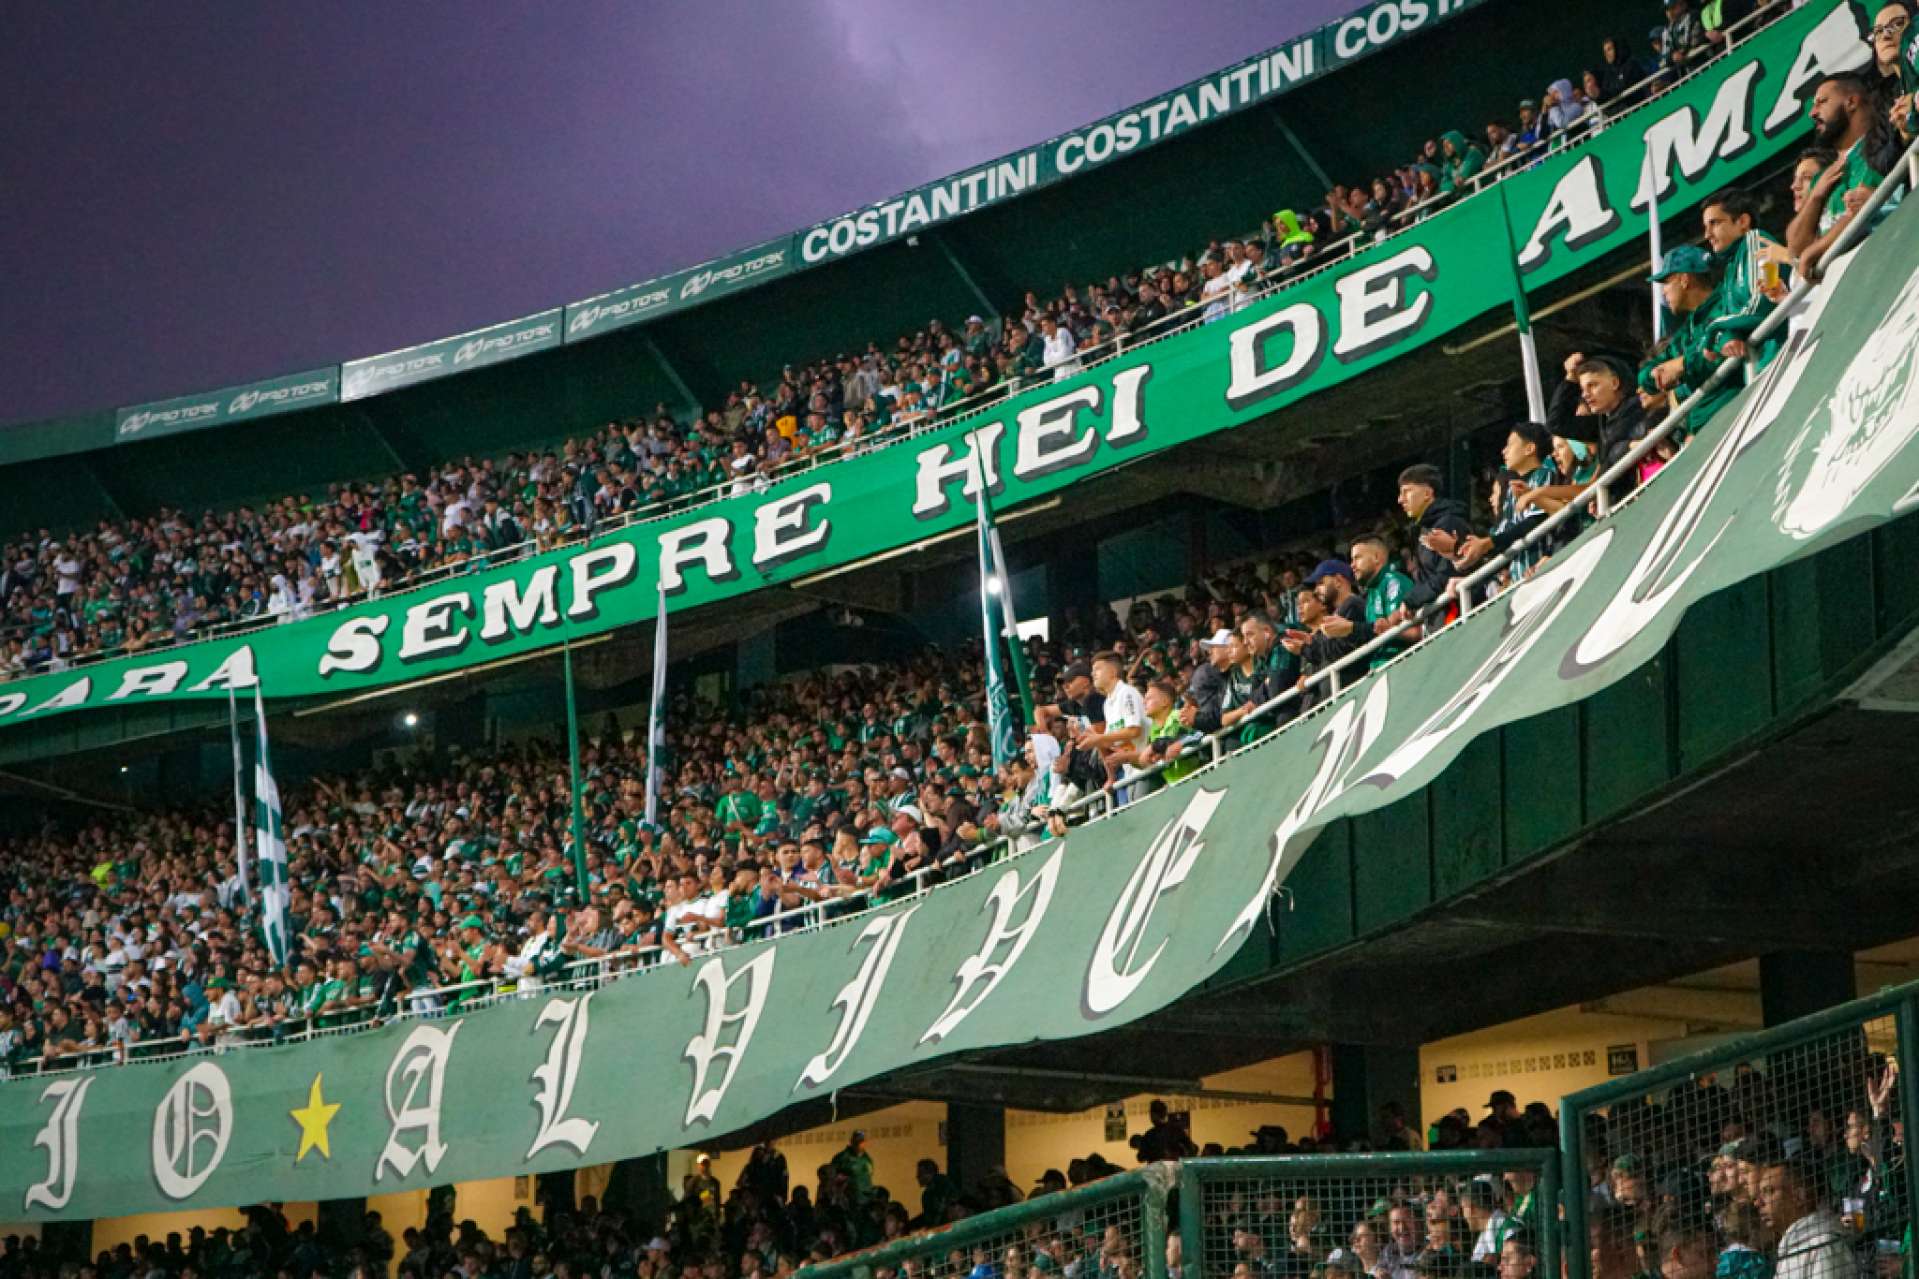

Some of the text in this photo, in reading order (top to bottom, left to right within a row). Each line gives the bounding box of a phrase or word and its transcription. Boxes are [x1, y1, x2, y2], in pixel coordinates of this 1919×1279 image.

[1335, 0, 1464, 58] COS
[1055, 39, 1314, 174] COSTANTINI
[801, 152, 1038, 264] COSTANTINI
[318, 482, 832, 677] SEMPRE
[912, 364, 1153, 517] HEI
[1226, 245, 1435, 405] DE
